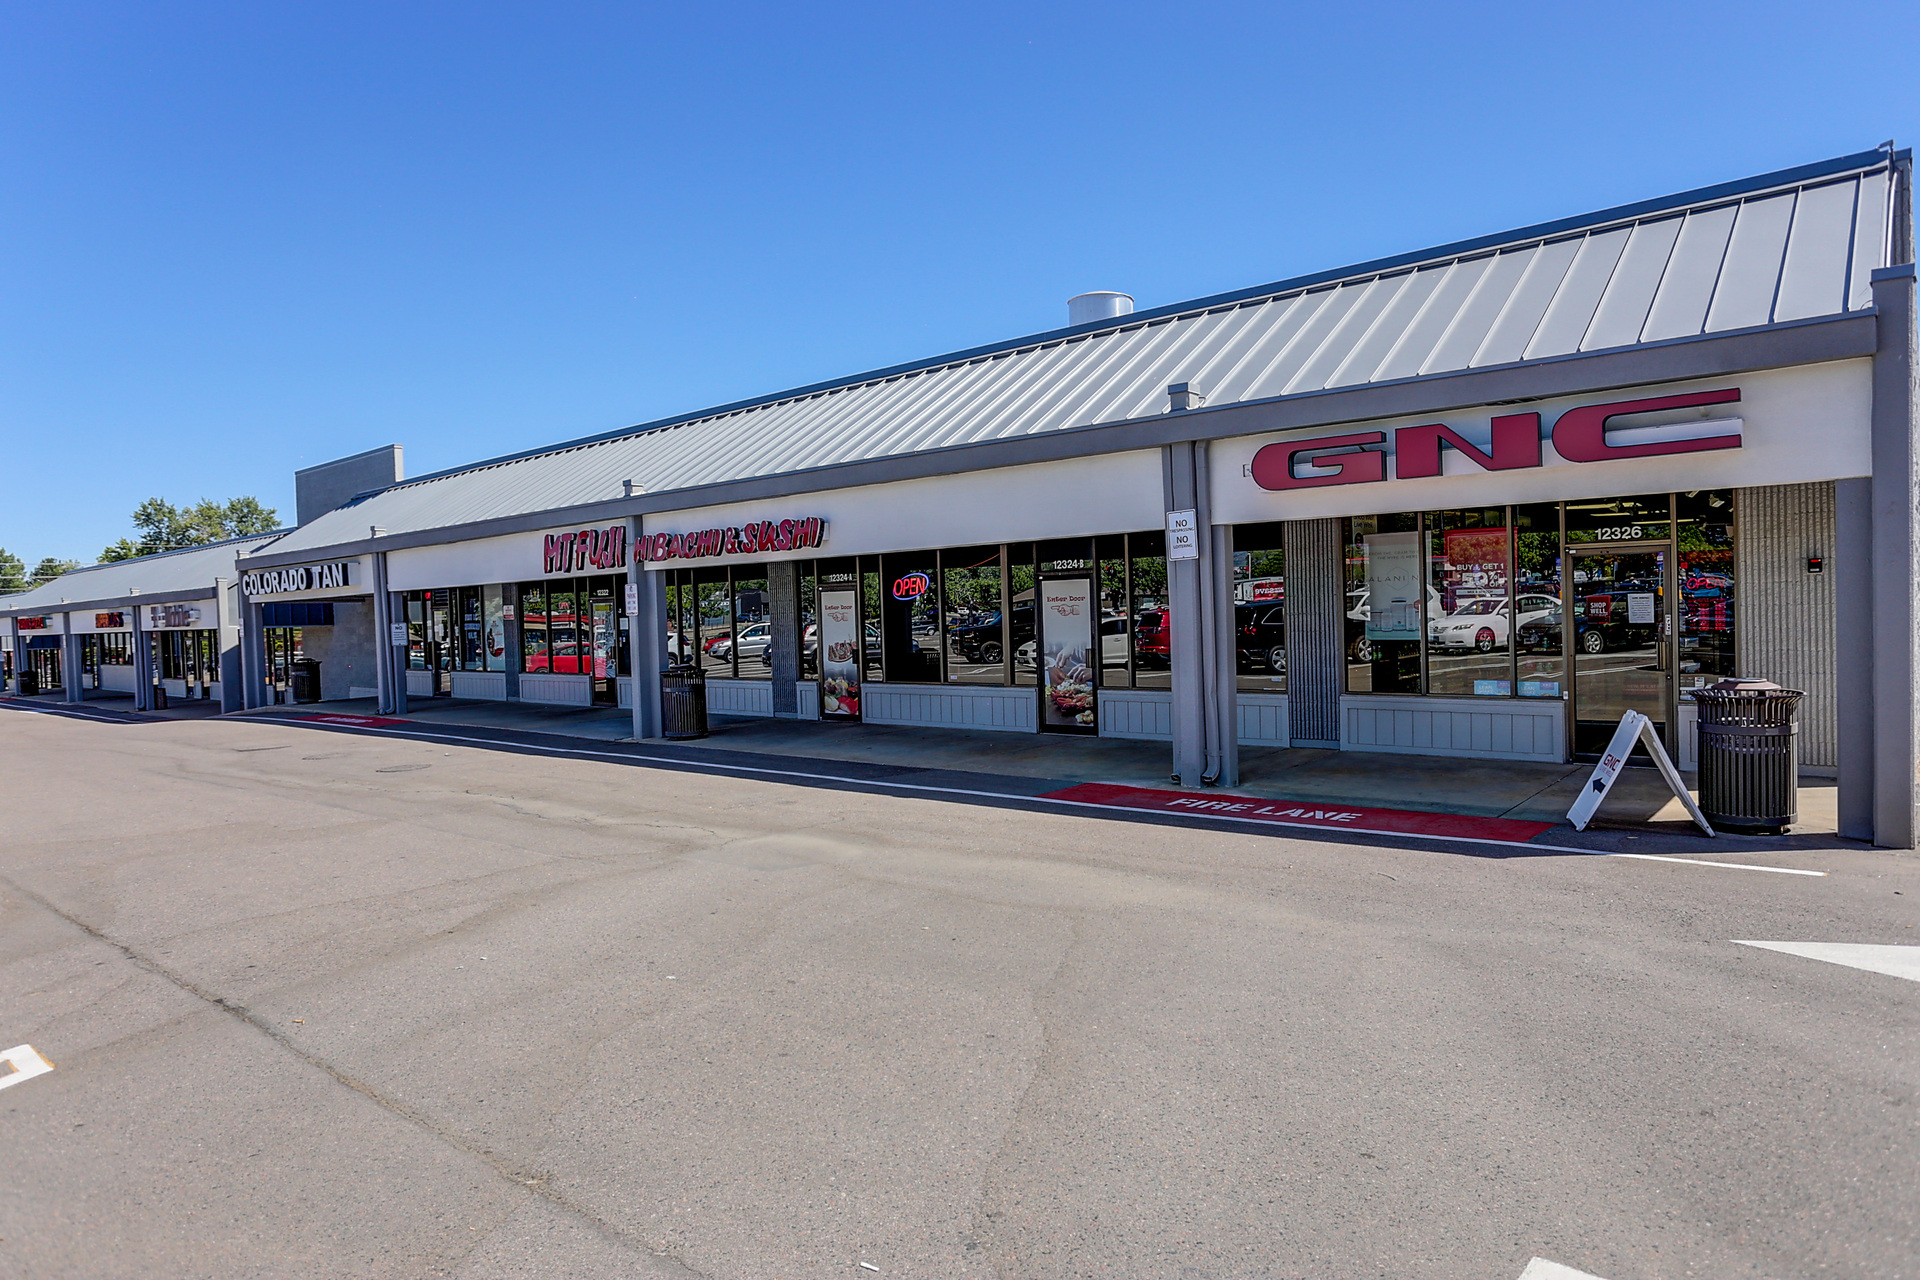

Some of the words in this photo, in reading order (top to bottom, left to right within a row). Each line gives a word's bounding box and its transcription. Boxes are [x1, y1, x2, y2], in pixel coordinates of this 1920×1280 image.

[1251, 388, 1743, 491] GNC
[1175, 519, 1188, 528] NO
[1595, 526, 1642, 540] 12326
[544, 534, 575, 573] MT
[575, 525, 627, 571] FUJI
[634, 529, 724, 563] HIBACHI
[724, 527, 740, 553] &
[742, 517, 826, 553] SUSHI
[1176, 535, 1189, 544] NO
[242, 567, 307, 596] COLORADO
[311, 563, 344, 589] TAN
[893, 577, 926, 596] OPEN
[1687, 577, 1726, 589] OPEN
[1603, 753, 1621, 772] GNC
[1166, 798, 1255, 813] FIRE
[1252, 806, 1363, 822] LANE
